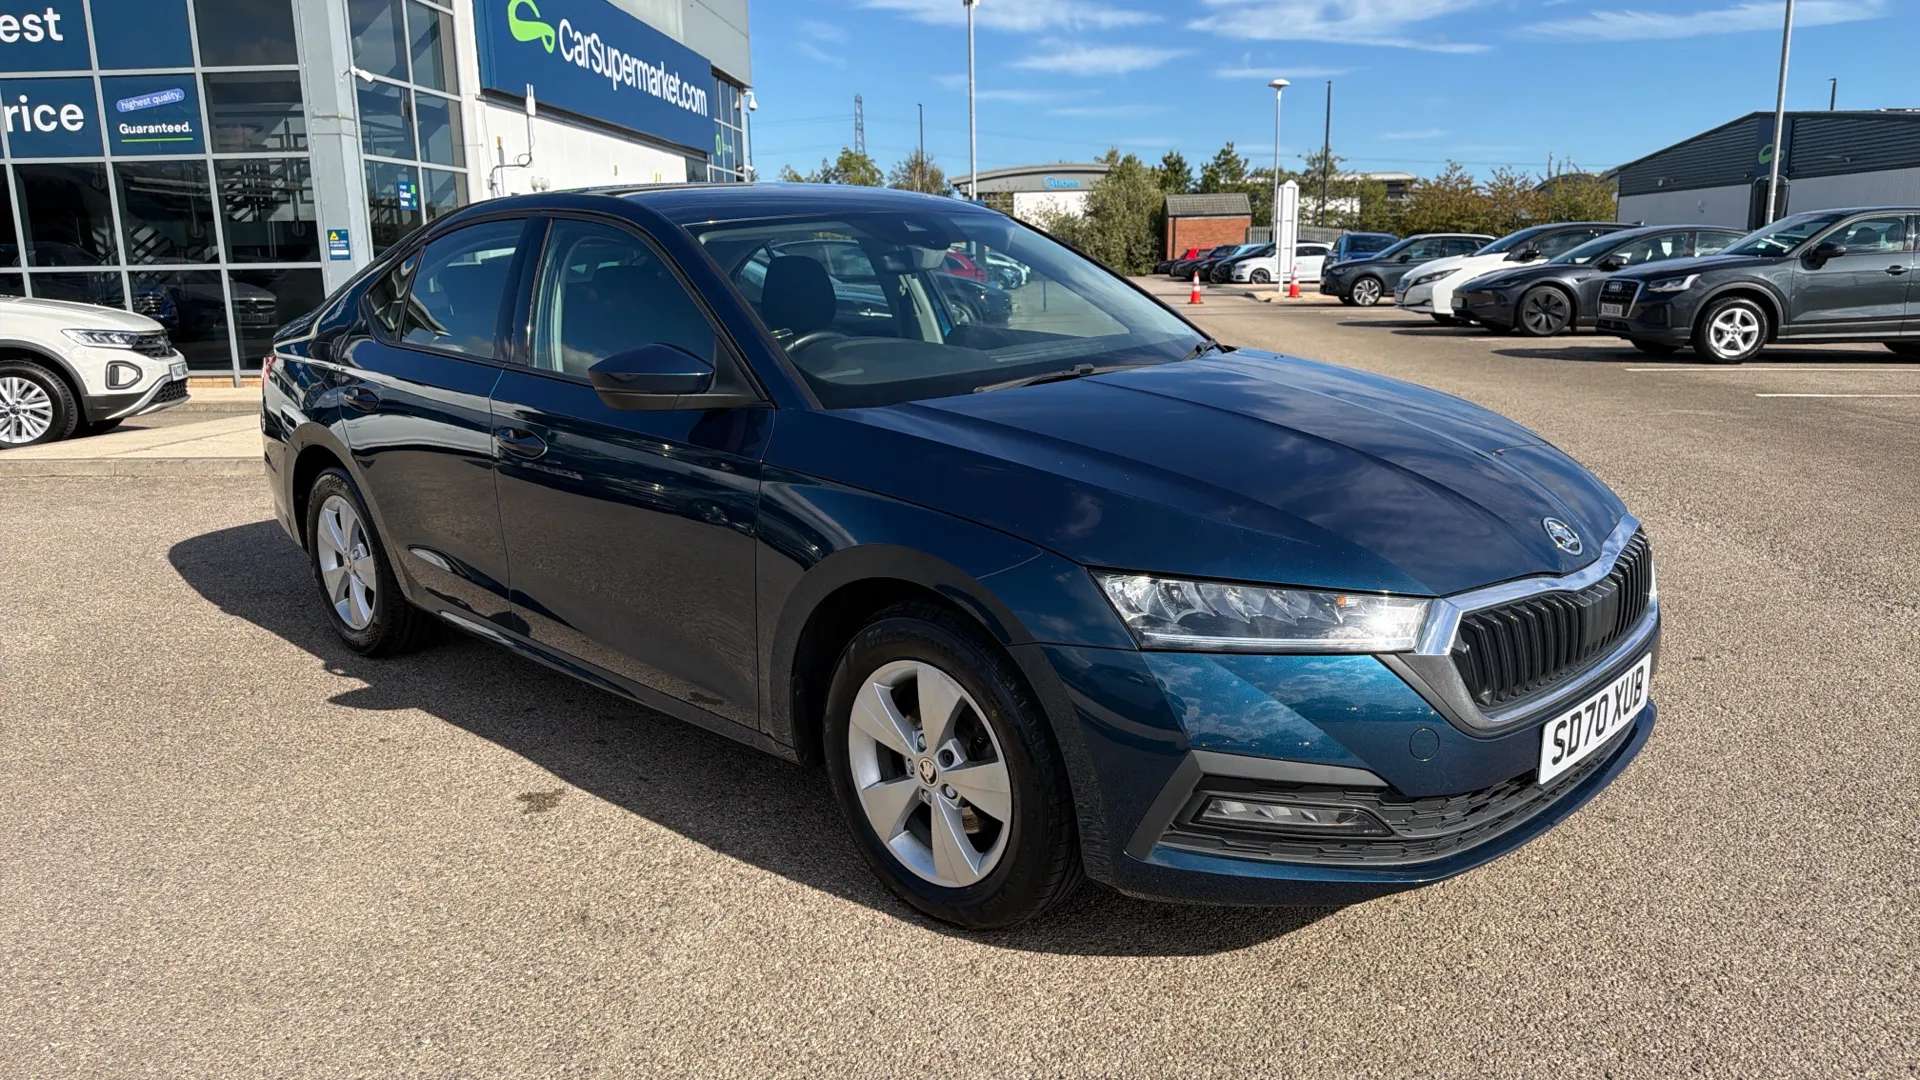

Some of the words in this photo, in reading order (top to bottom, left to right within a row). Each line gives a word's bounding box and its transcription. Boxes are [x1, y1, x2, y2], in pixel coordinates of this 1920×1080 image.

[0, 7, 64, 43] est
[558, 18, 708, 117] CarSupermarket.com
[3, 94, 85, 132] rice
[120, 98, 151, 111] highest
[152, 91, 182, 105] quality.
[119, 121, 193, 134] Guaranteed.
[1552, 693, 1609, 766] SD70
[1612, 665, 1645, 725] XUB
